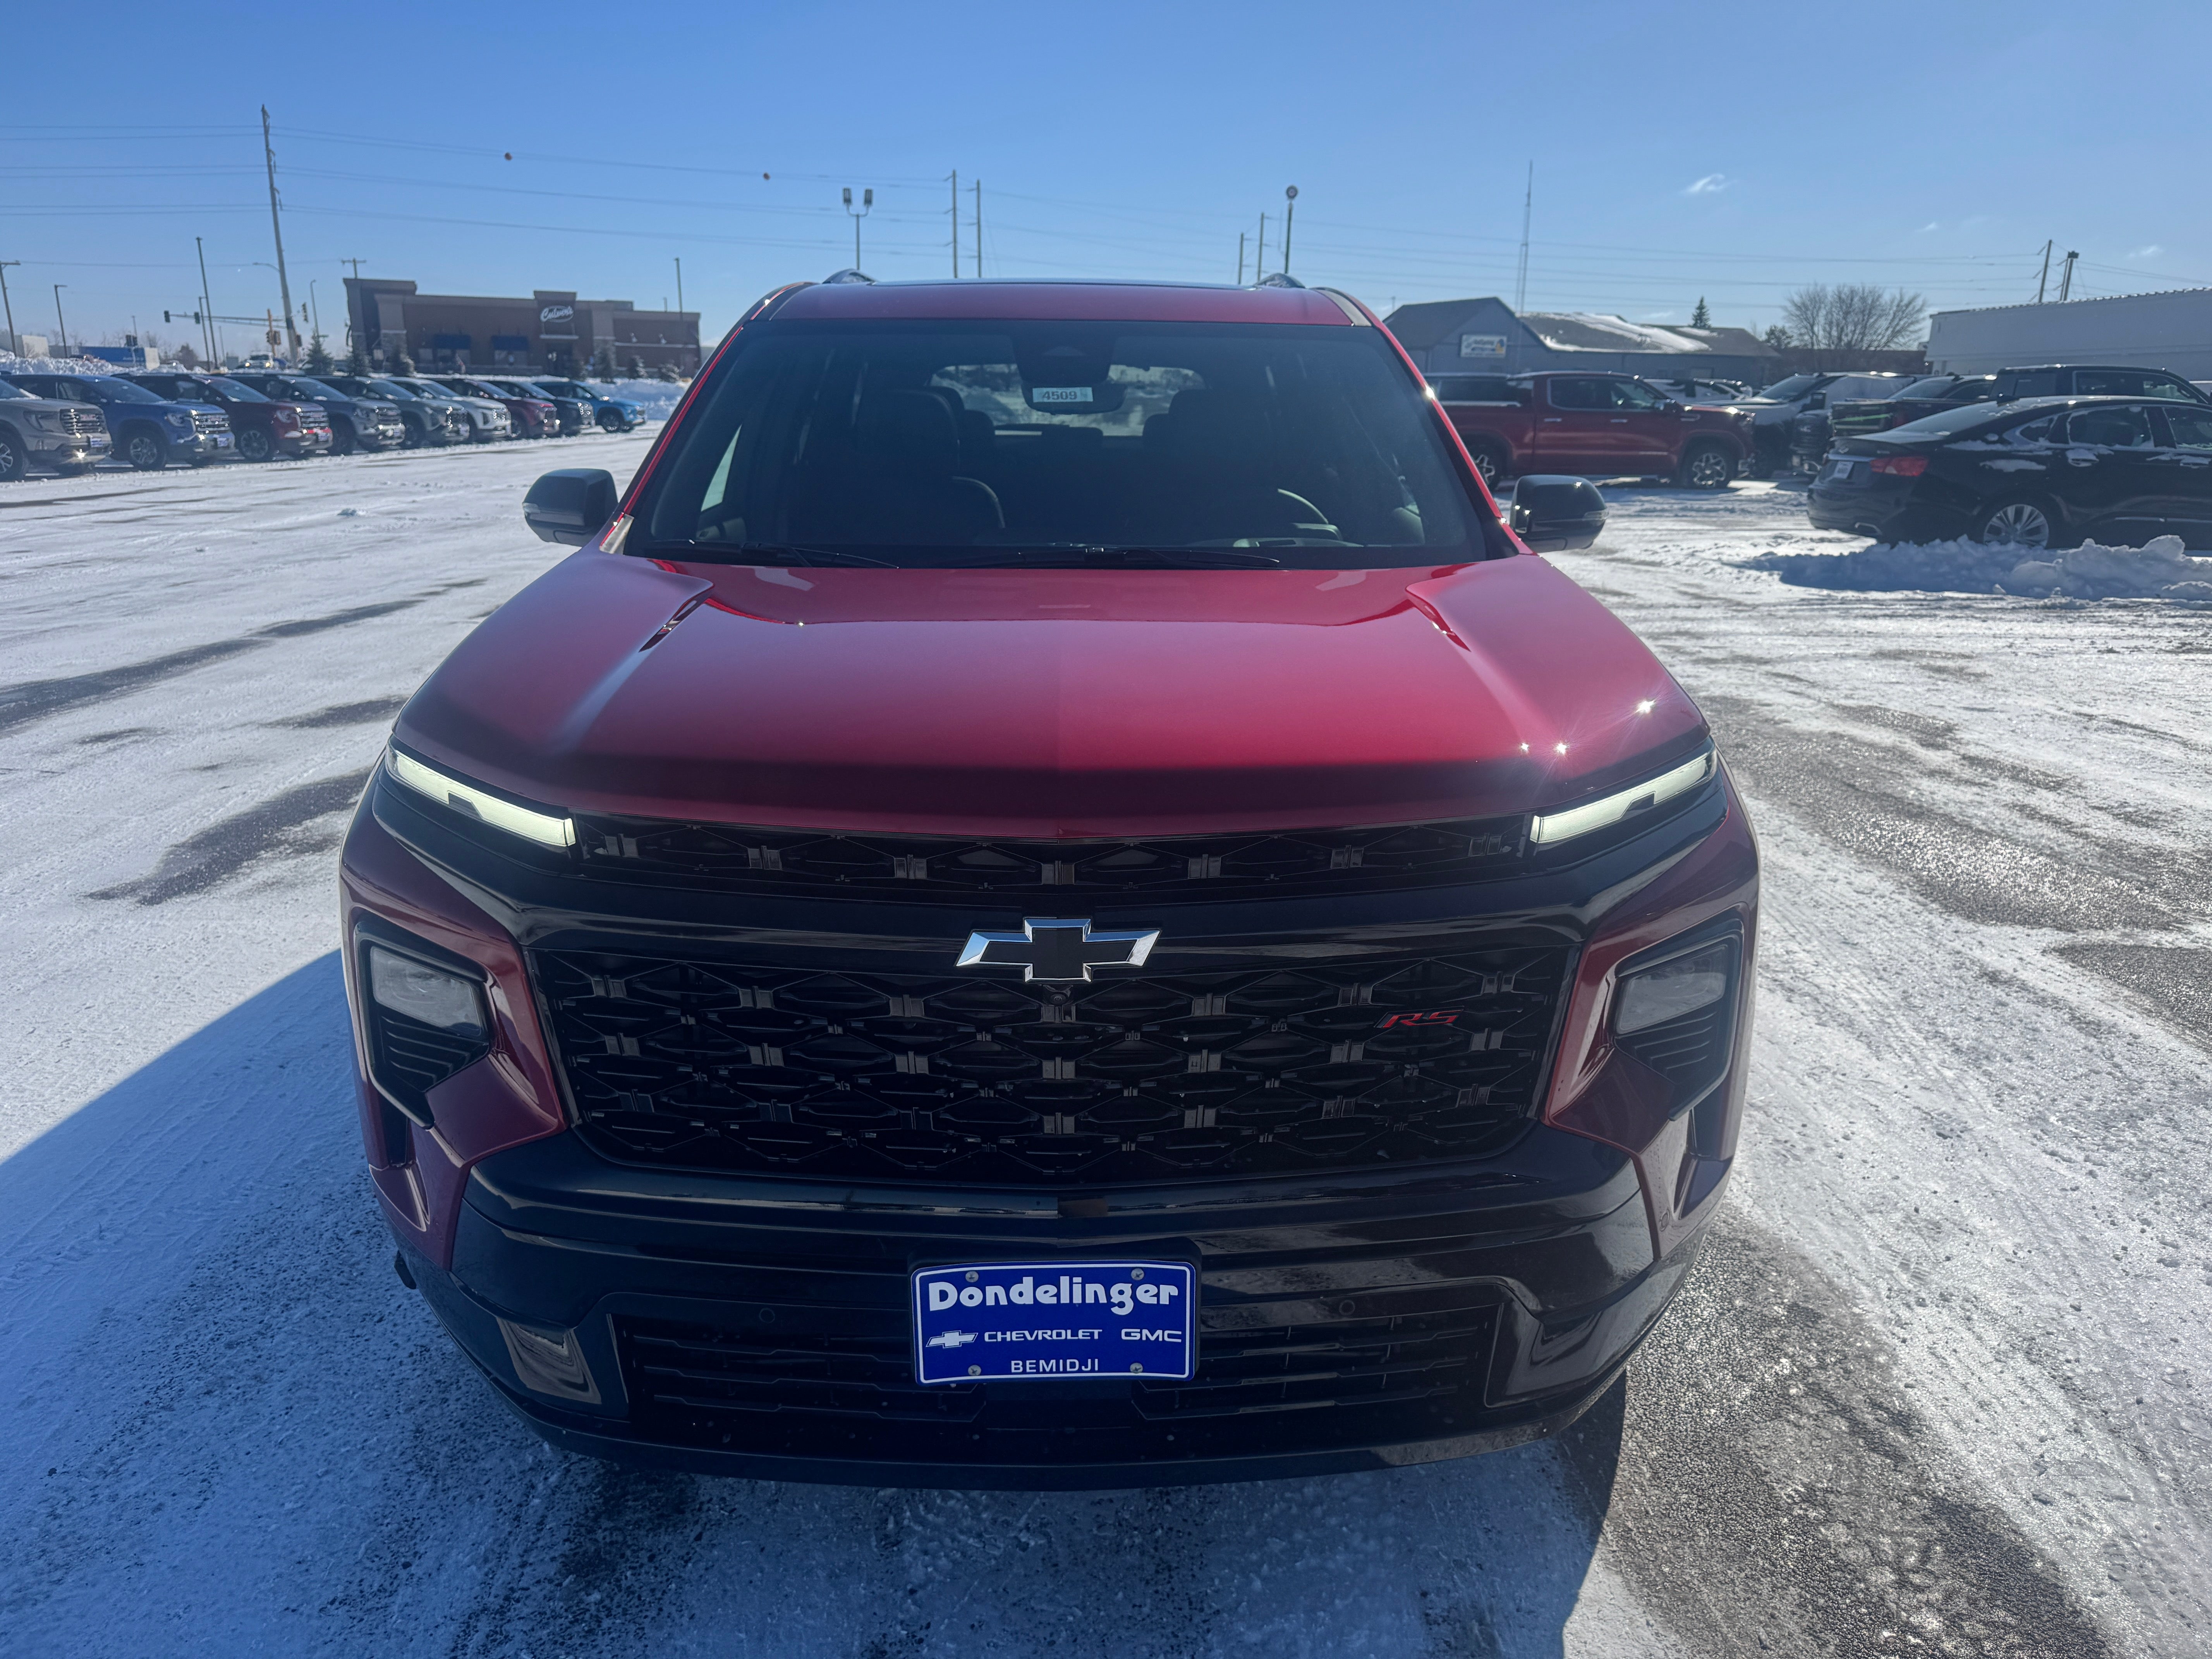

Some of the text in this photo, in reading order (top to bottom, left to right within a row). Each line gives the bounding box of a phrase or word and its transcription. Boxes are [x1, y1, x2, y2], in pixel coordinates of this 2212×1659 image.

[1042, 390, 1077, 400] 4509
[1382, 1009, 1462, 1029] RS
[928, 1276, 1178, 1316] Dondelinger
[984, 1328, 1182, 1343] CHEVROLET GMC
[1010, 1358, 1099, 1373] BEMIDJI
